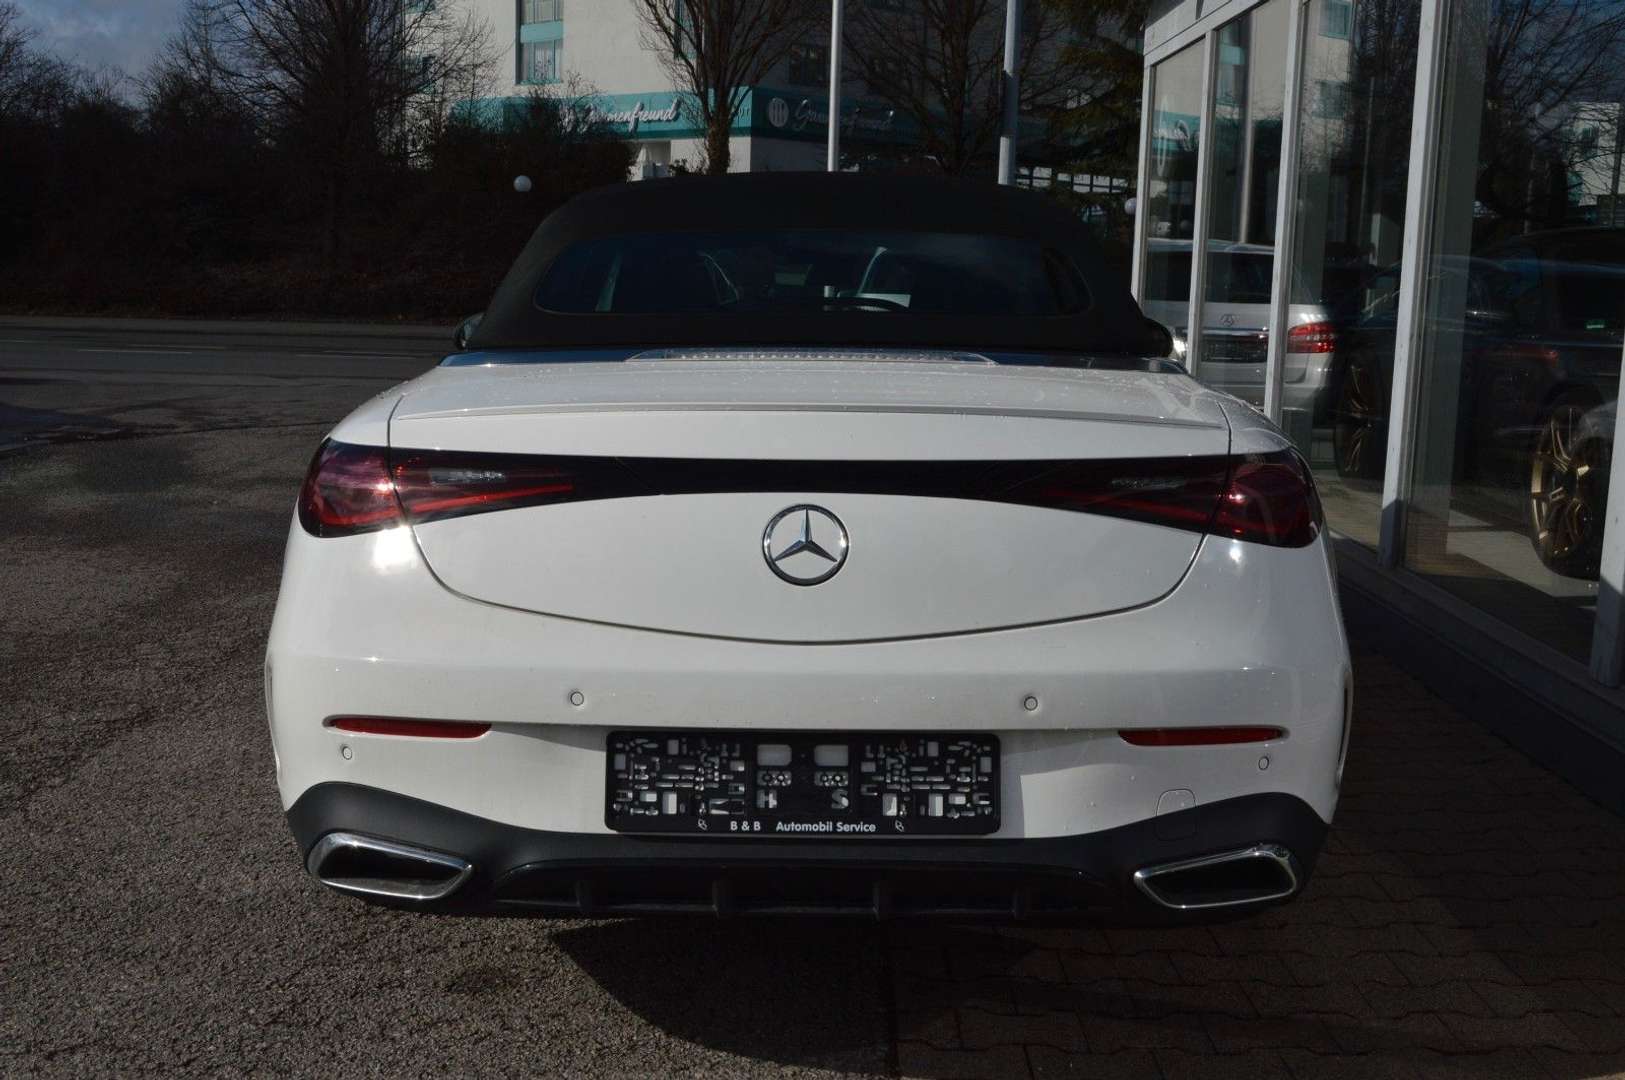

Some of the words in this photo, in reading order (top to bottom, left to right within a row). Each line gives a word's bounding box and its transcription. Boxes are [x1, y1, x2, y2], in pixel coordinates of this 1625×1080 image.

[730, 821, 738, 831] B
[741, 821, 750, 831] &
[753, 821, 761, 831] B
[776, 821, 833, 832] Automobil
[836, 821, 876, 832] Service
